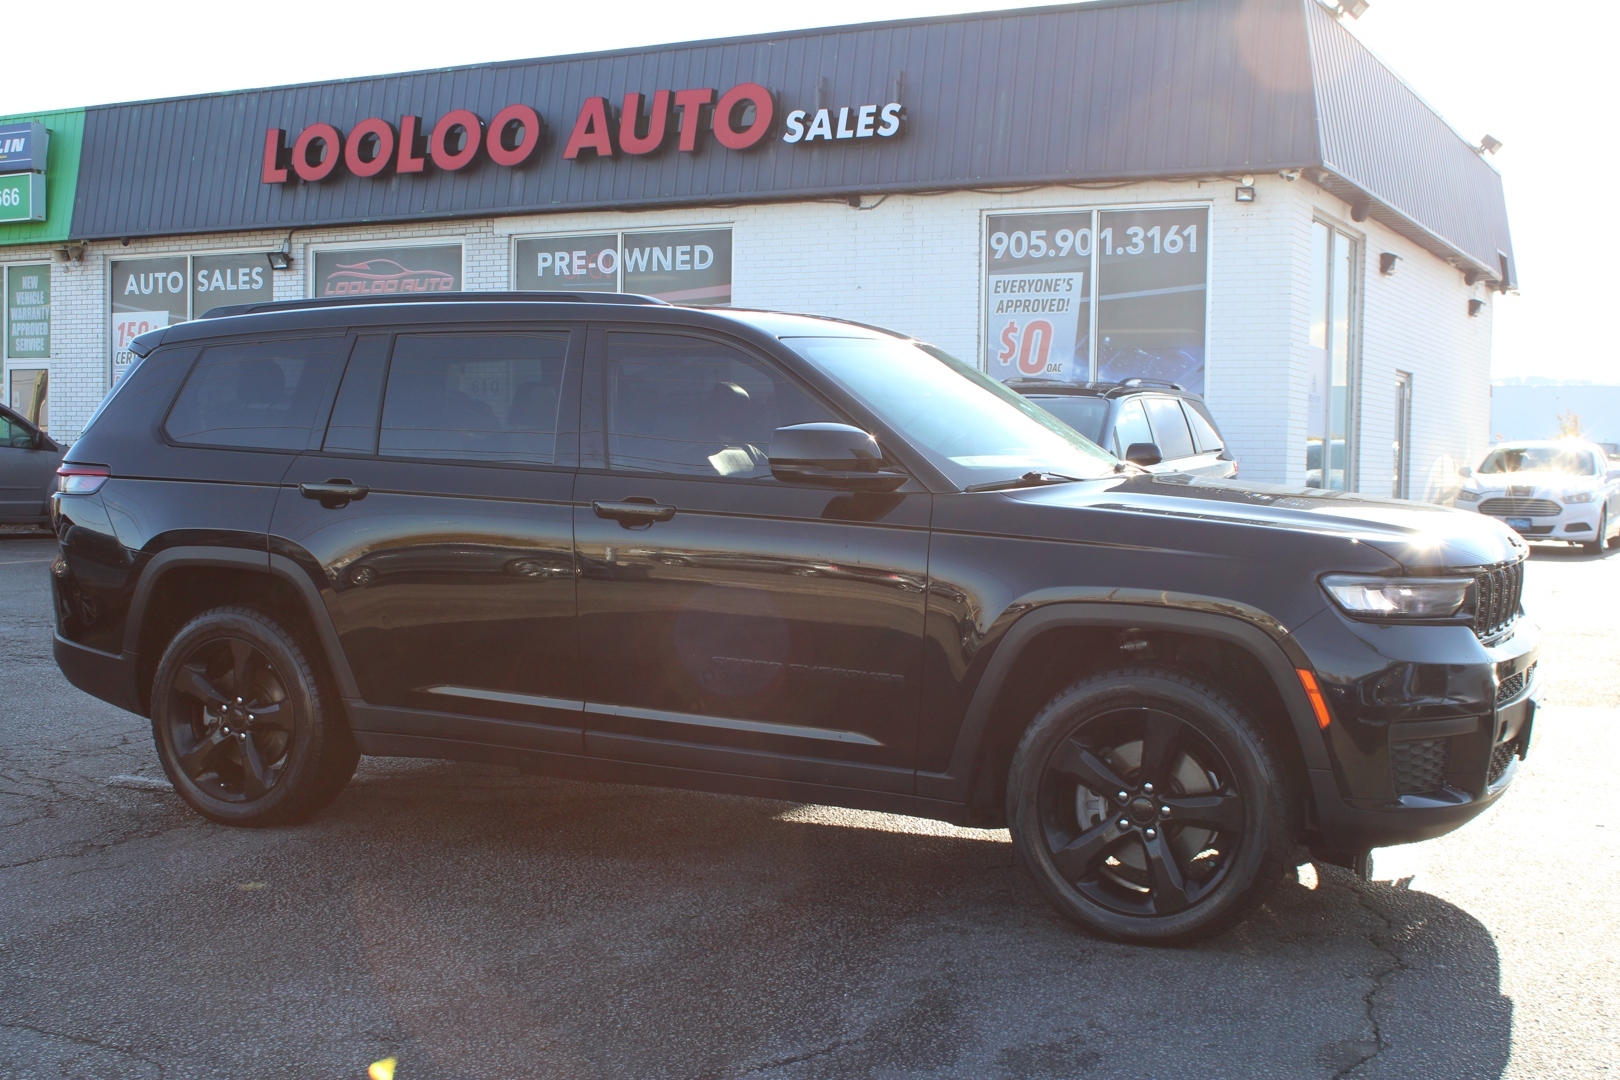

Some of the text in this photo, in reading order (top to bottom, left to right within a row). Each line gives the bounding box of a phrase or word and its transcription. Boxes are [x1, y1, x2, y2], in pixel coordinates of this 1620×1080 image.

[262, 82, 902, 184] LOOLOO AUTO SALES
[0, 187, 20, 207] 66
[990, 224, 1197, 259] 905.901.3161
[537, 245, 714, 277] PRE-OWNED
[22, 275, 39, 290] NEW
[124, 267, 264, 296] AUTO SALES
[324, 277, 454, 296] LOOLOO AUTO
[993, 278, 1074, 295] EVERYONE'S
[16, 291, 45, 306] VEHICLE
[995, 298, 1071, 314] APPROVED!
[11, 306, 50, 321] WARRANTY
[12, 321, 49, 336] APPROVED
[15, 338, 45, 352] SERVICE
[999, 320, 1063, 375] $0 OAC
